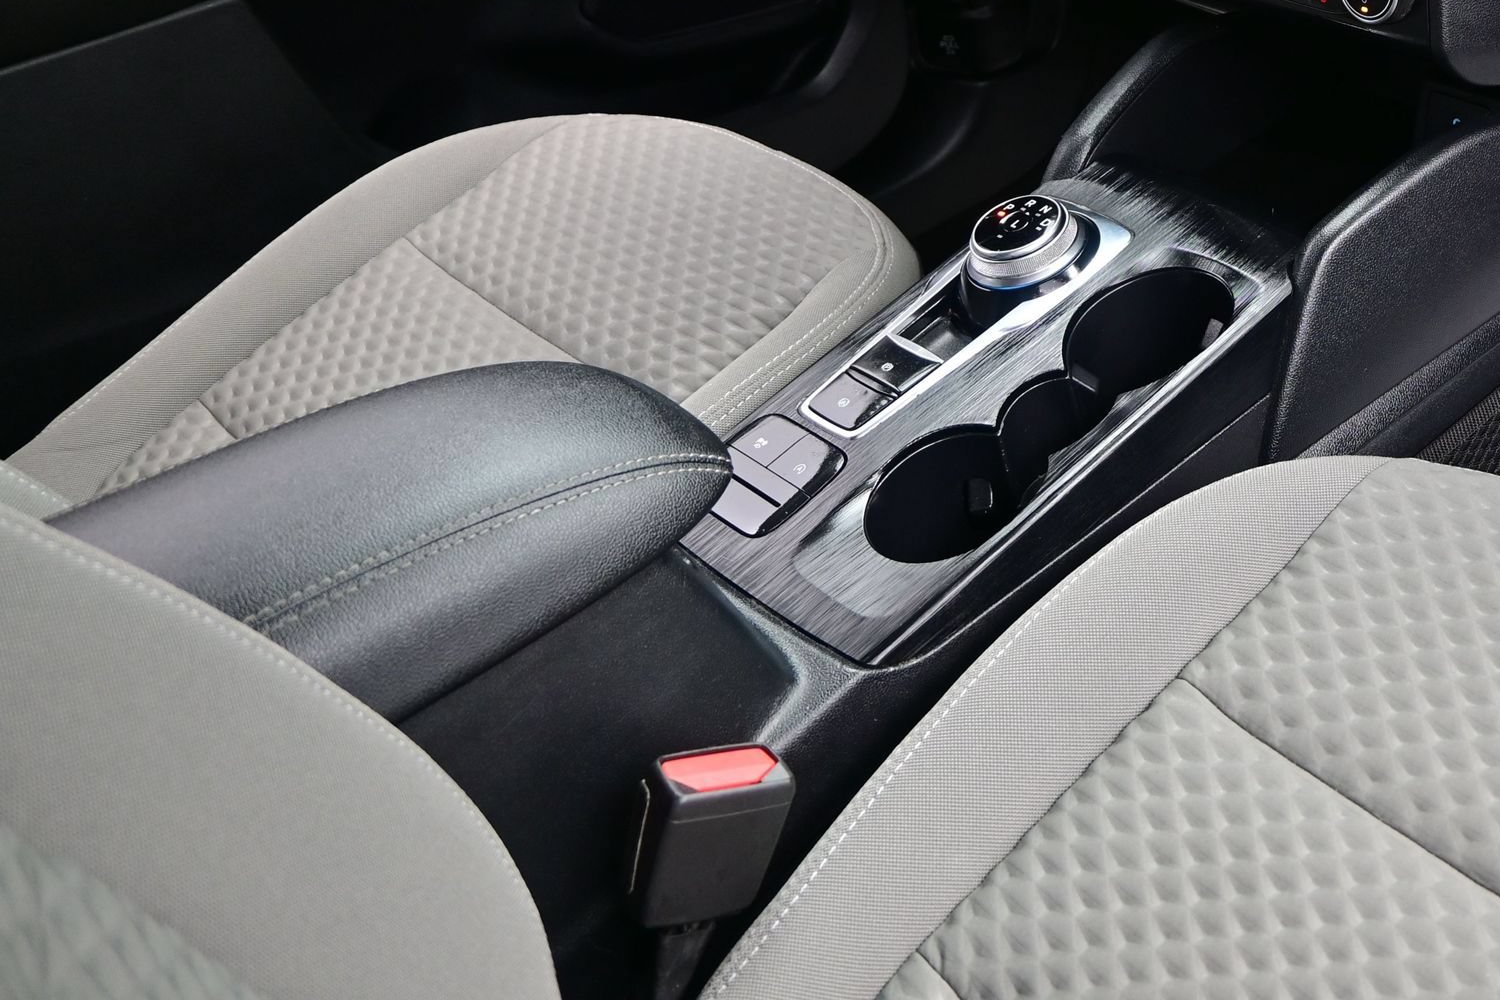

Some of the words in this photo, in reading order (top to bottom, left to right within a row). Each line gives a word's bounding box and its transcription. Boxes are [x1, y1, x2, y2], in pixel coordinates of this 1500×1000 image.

[1003, 203, 1015, 211] P
[1024, 199, 1037, 208] R
[1039, 204, 1053, 214] N
[1010, 219, 1020, 229] L
[1039, 218, 1051, 227] D
